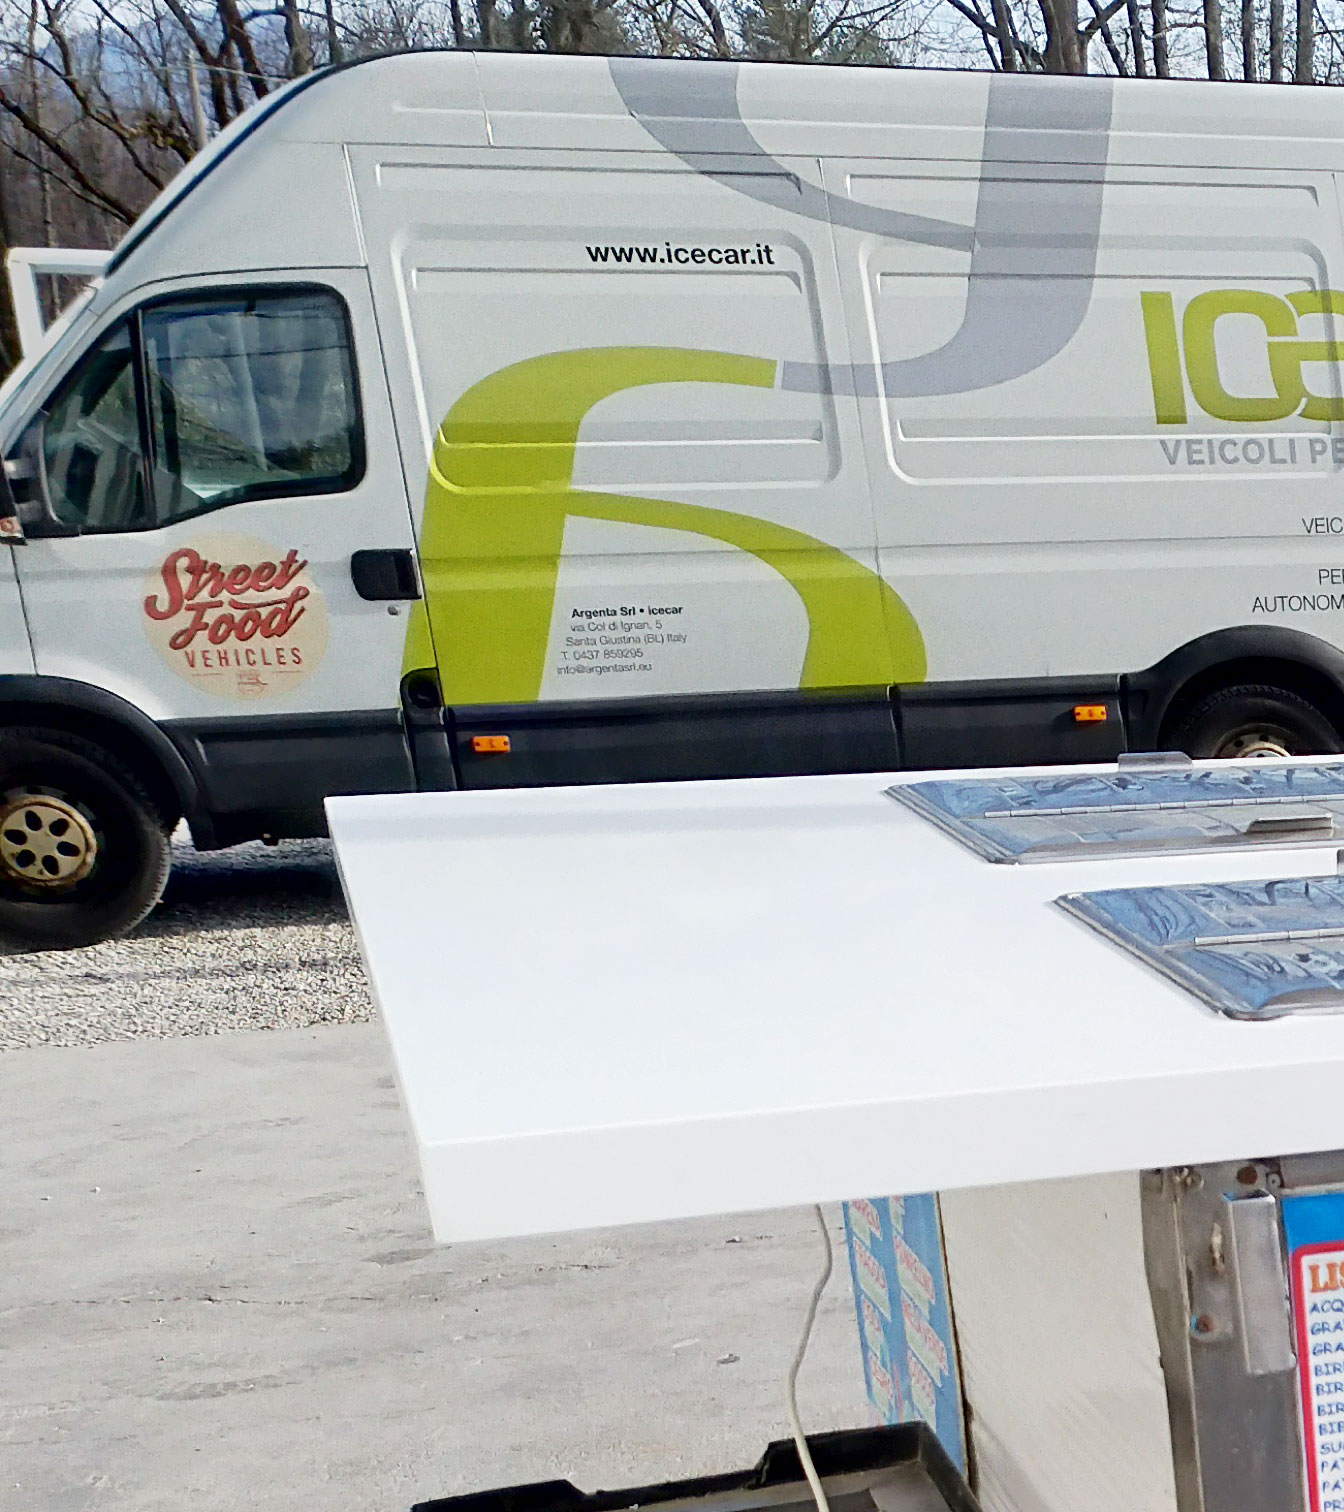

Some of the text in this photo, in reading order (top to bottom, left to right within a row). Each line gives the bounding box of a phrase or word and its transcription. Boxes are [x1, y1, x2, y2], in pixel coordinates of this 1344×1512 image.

[586, 241, 775, 267] www.icecar.it
[1159, 437, 1297, 466] VEICOLI
[144, 548, 308, 620] Street
[169, 586, 310, 650] Food
[571, 607, 617, 619] Argenta
[184, 647, 302, 668] VEHICLES
